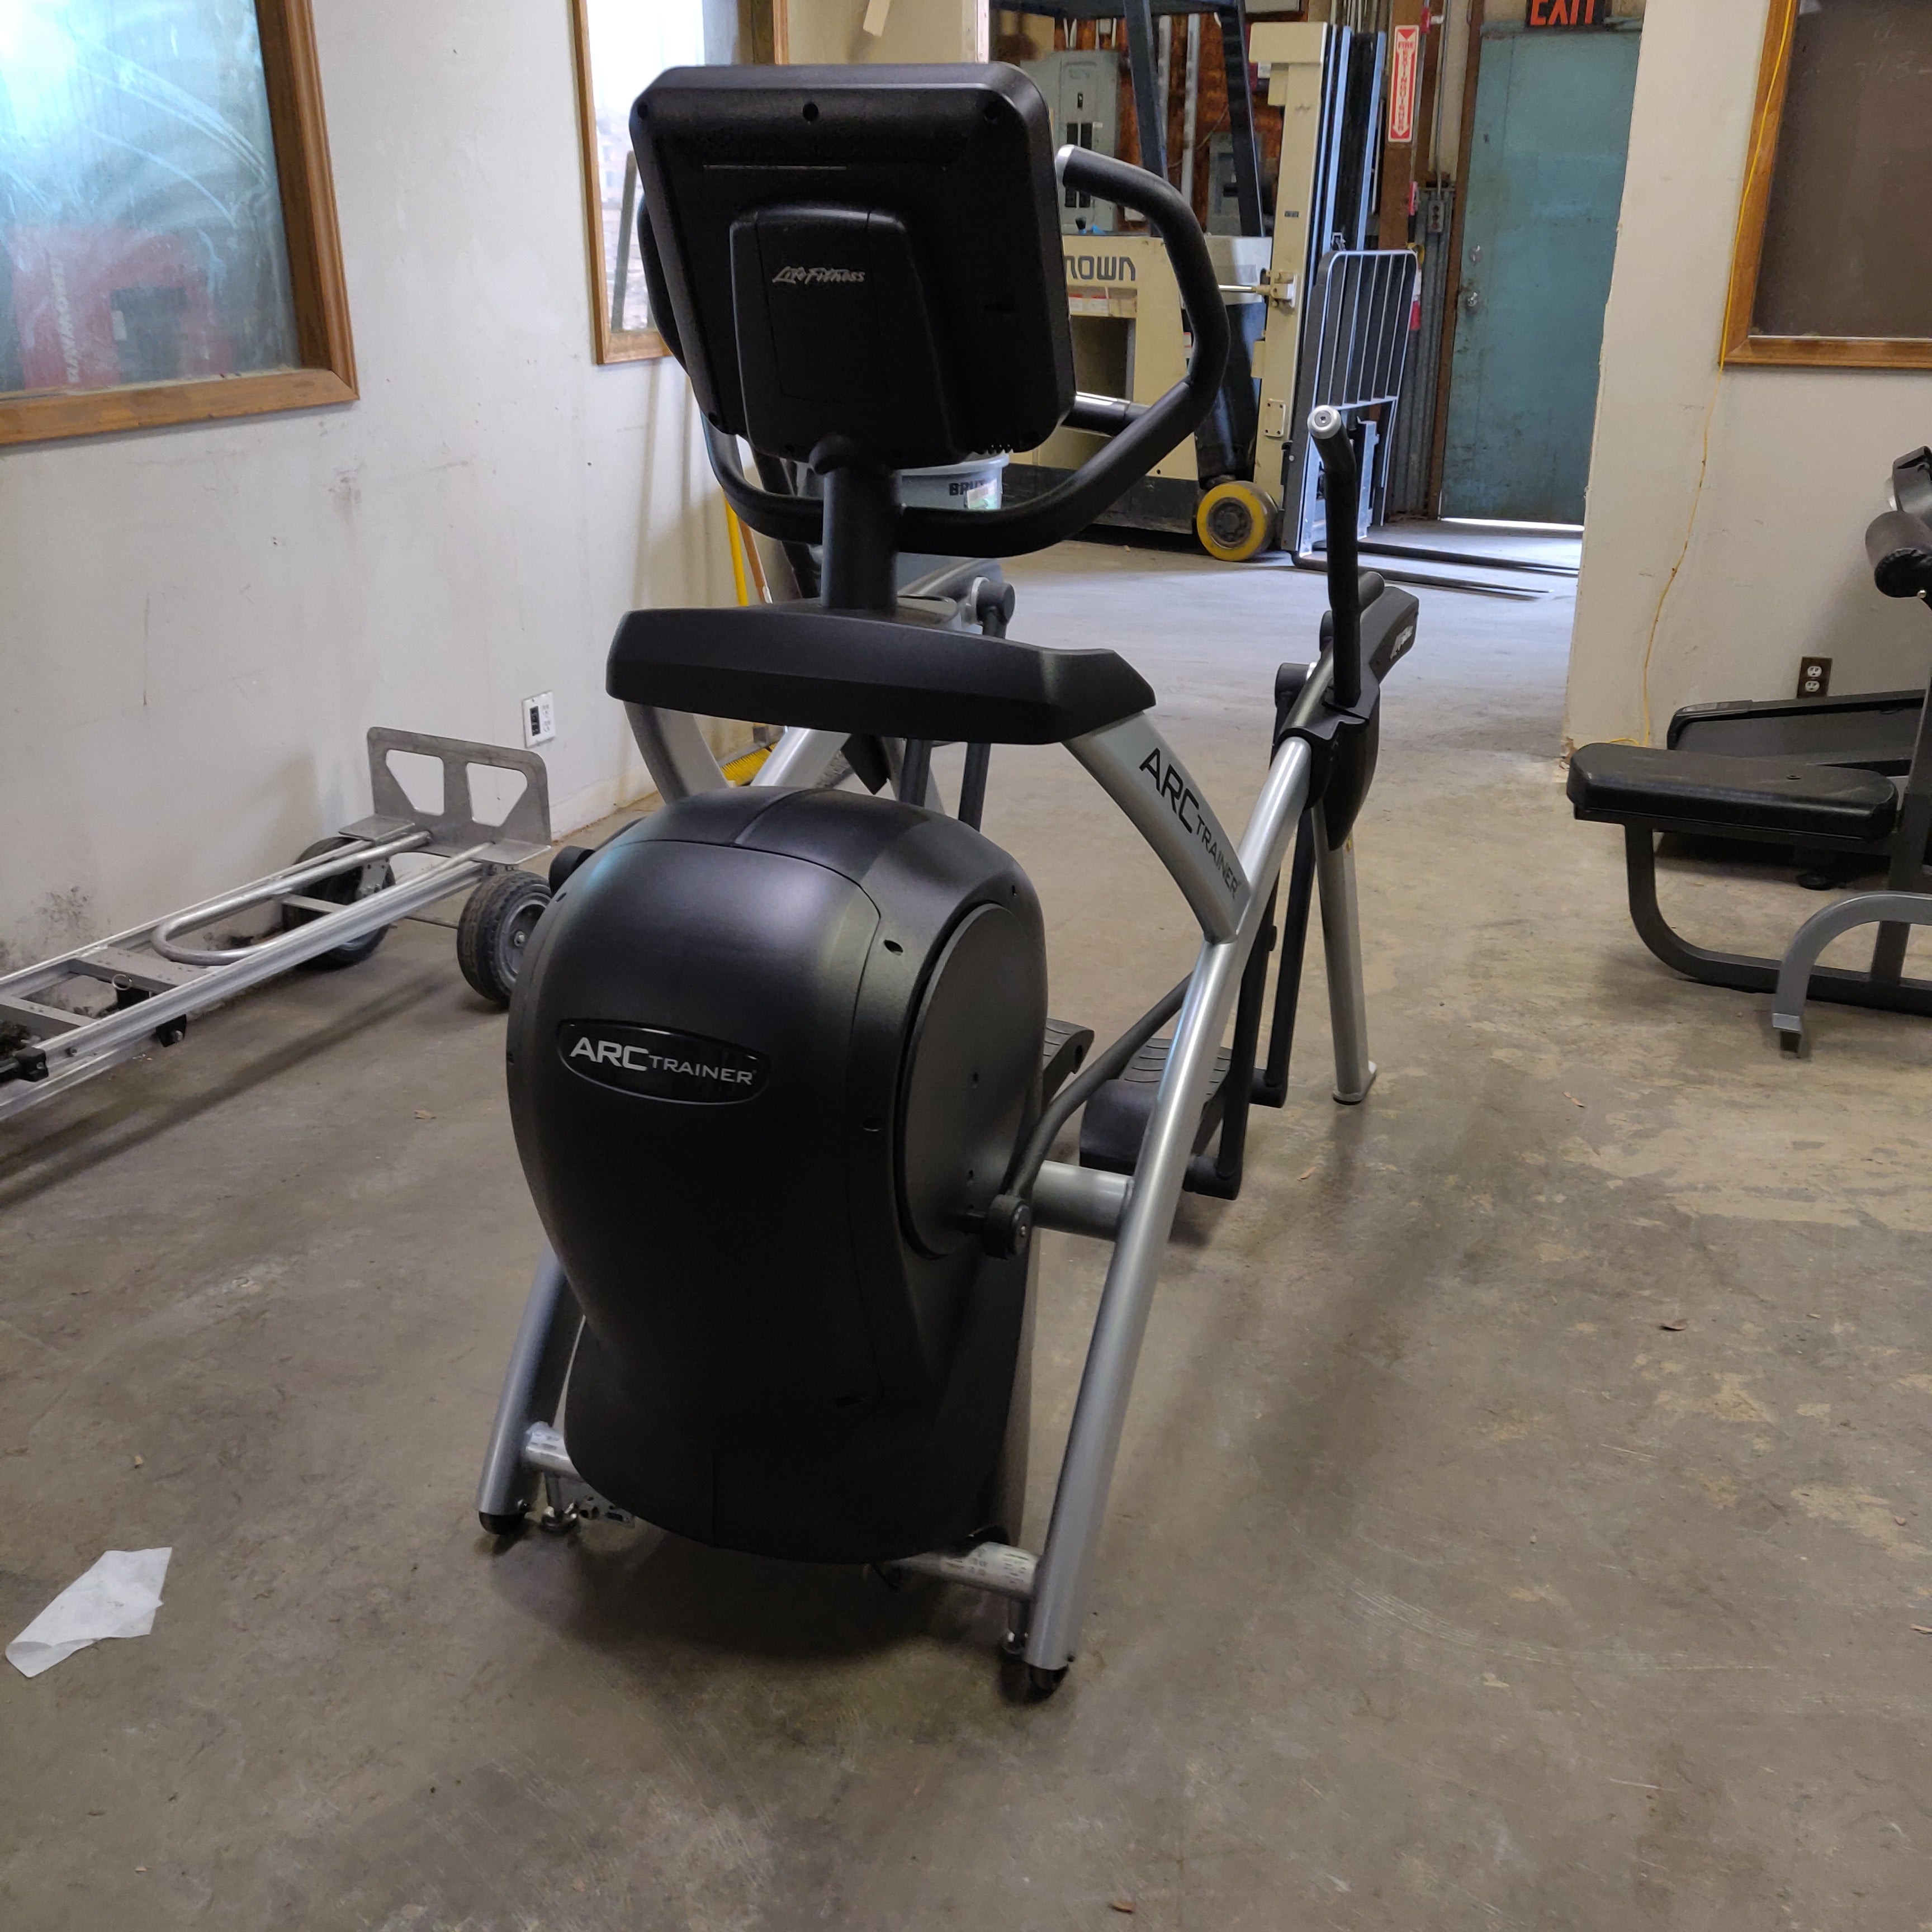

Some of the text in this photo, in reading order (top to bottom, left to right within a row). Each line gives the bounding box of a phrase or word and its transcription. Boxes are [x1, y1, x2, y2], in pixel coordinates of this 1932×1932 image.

[1064, 255, 1135, 281] ROWN
[1139, 747, 1238, 899] ARC TRAINER
[570, 1037, 753, 1085] ARC TRAINER
